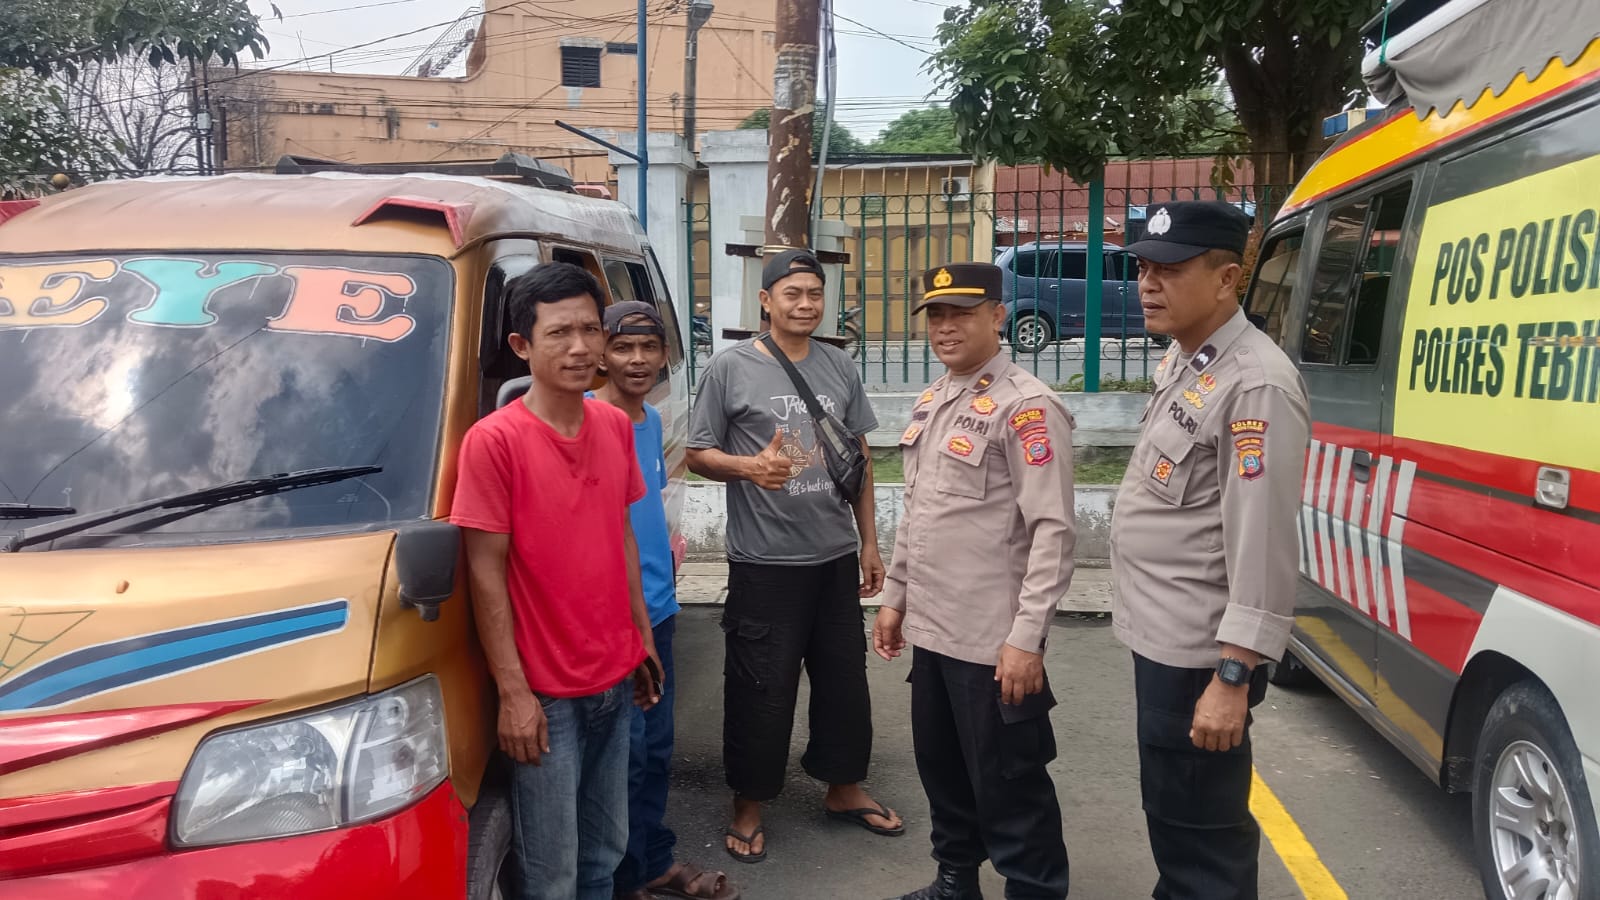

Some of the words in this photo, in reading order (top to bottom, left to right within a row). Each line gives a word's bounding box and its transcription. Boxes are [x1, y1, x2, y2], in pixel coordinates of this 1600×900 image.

[1429, 232, 1490, 306] POS
[1409, 323, 1508, 397] POLRES
[953, 414, 990, 435] POLRI
[1168, 401, 1198, 435] POLRI
